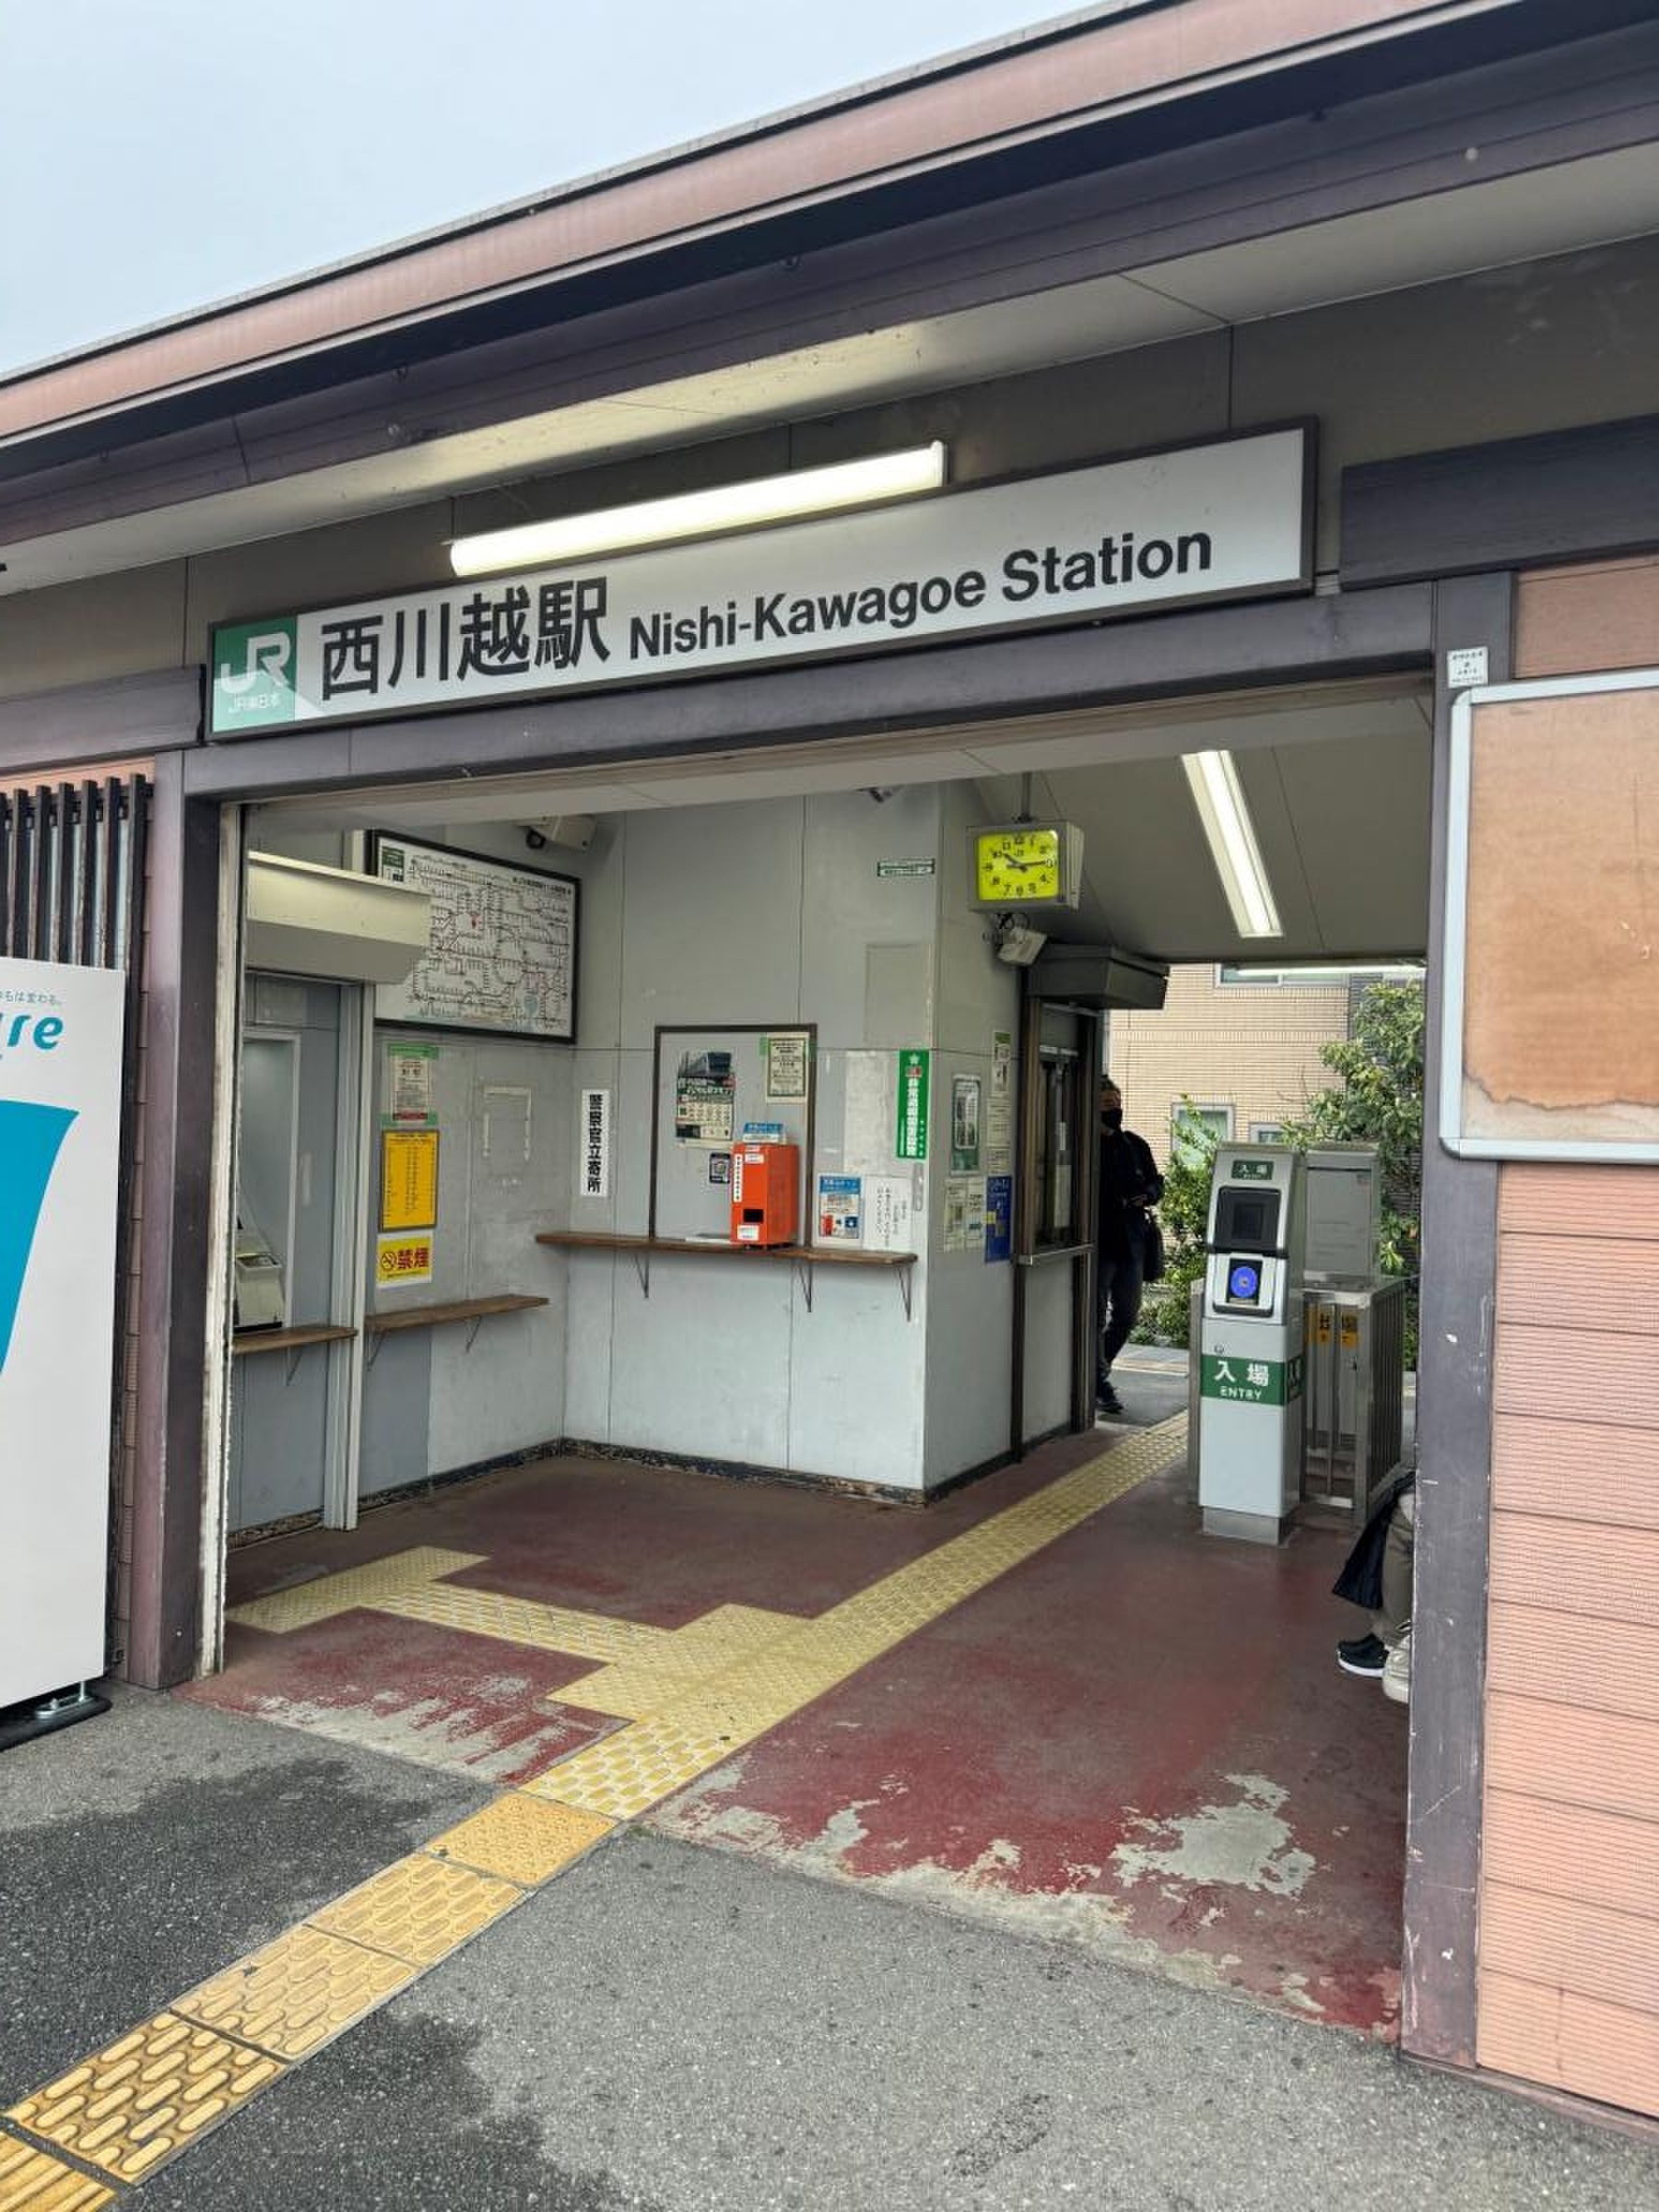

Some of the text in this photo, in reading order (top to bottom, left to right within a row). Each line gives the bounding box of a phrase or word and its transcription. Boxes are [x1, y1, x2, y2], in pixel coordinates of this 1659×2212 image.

[320, 531, 1212, 700] 西川越駅 Nishi-Kawagoe Station
[220, 632, 289, 694] JR
[0, 1012, 64, 1050] re
[397, 1247, 429, 1269] 禁煙
[1213, 1359, 1269, 1386] 入場
[1219, 1385, 1262, 1400] ENTRY
